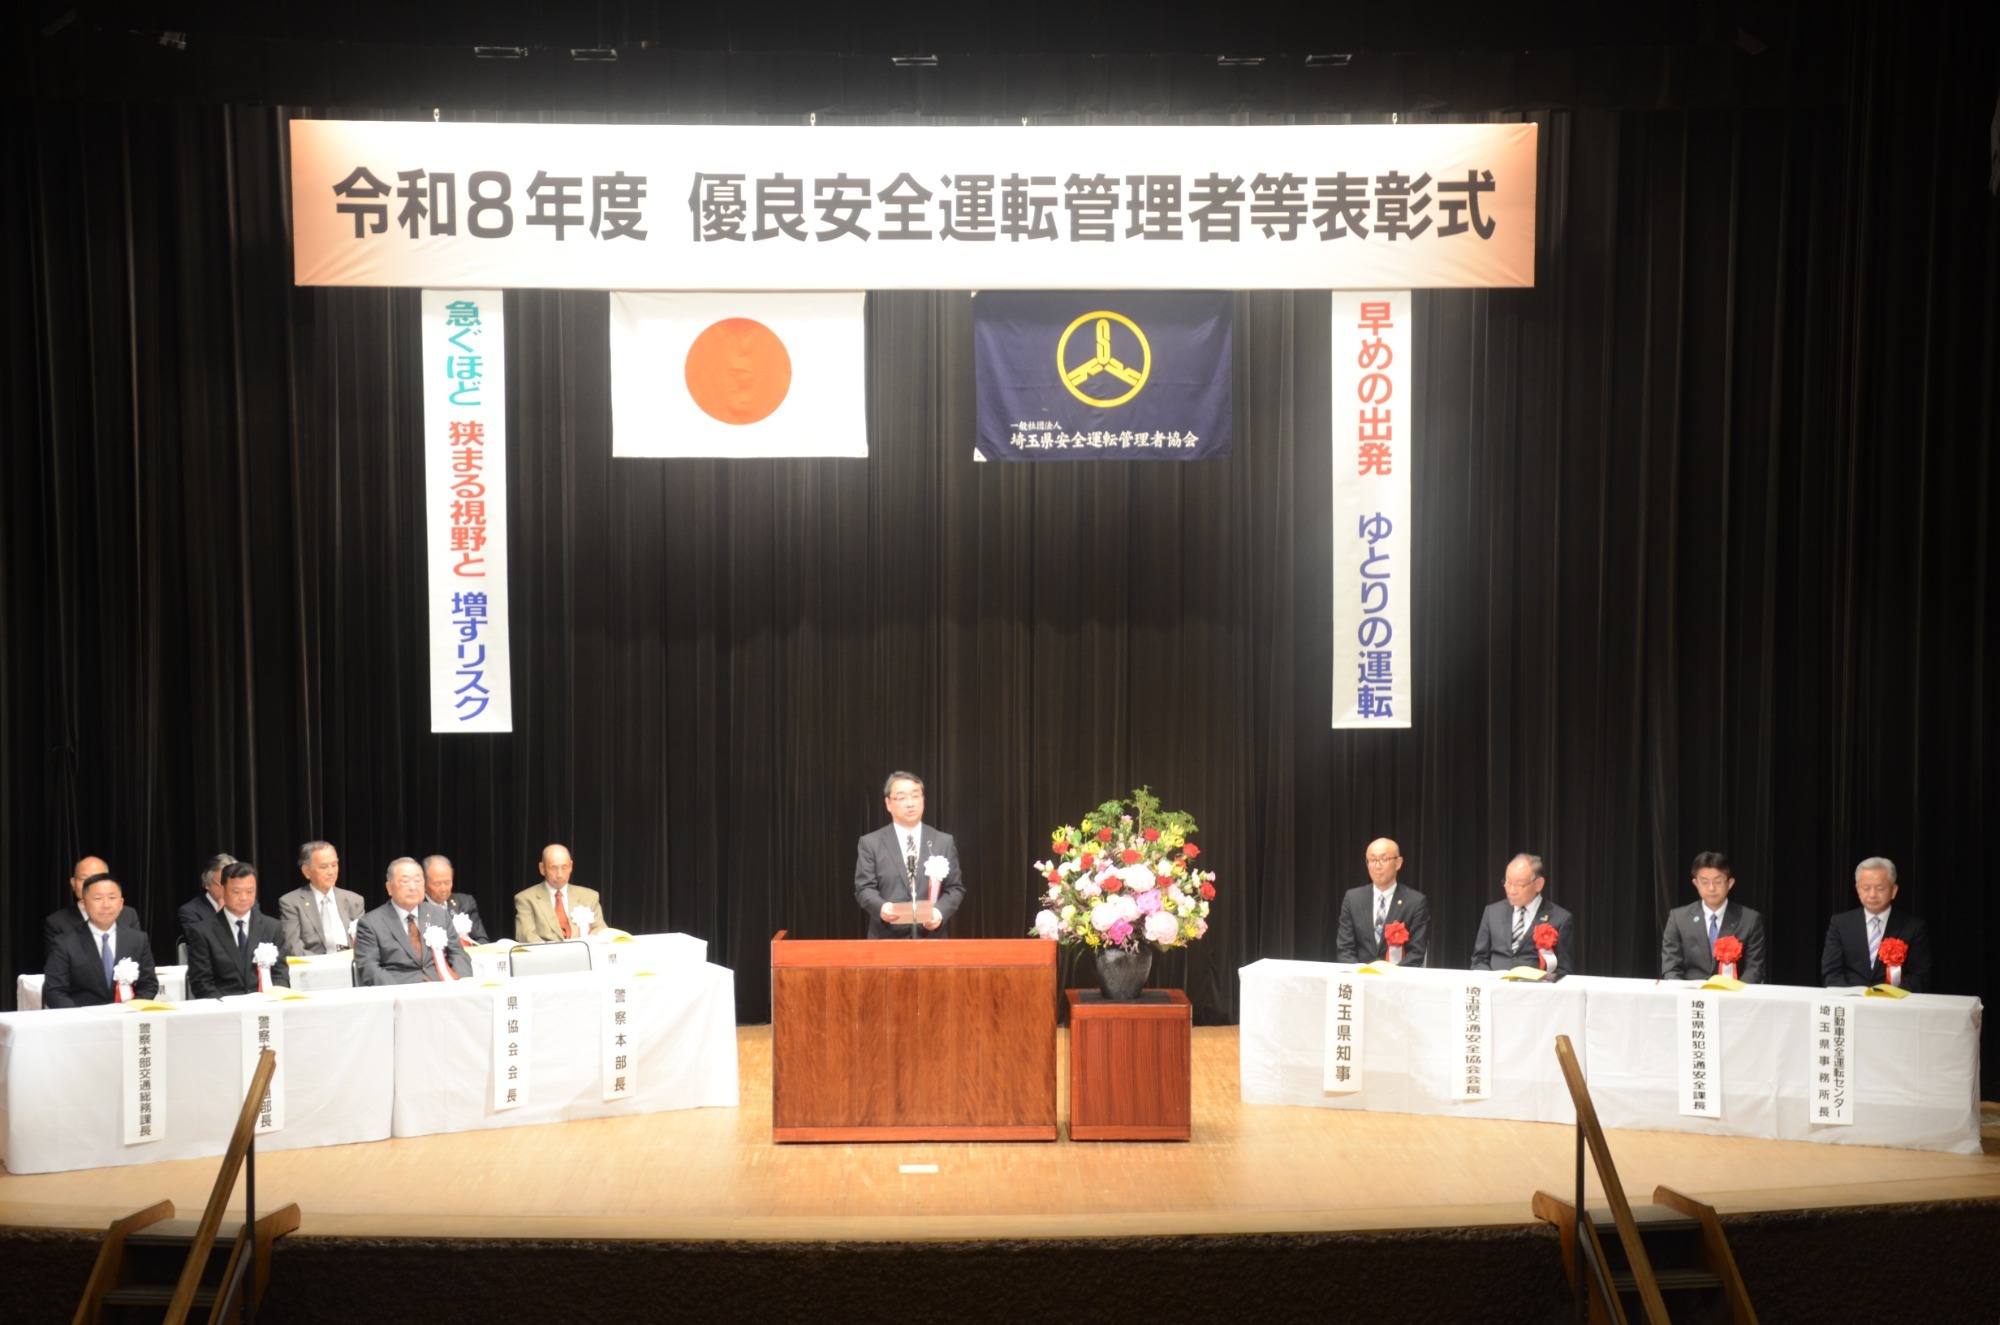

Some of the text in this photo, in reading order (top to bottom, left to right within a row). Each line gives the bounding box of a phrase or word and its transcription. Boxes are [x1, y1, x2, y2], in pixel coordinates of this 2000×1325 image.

[332, 166, 1497, 243] 令和8年度 優良安全運転管理者等表彰式
[1010, 420, 1062, 431] 一般社団法人
[1010, 430, 1199, 450] 埼玉県安全運転管理者協会
[445, 300, 490, 721] 急ぐほど 狭まる視野と 増すリスク
[1357, 302, 1394, 719] 早めの出発 ゆとりの運転
[138, 1022, 152, 1137] 警察本部交通総務課長
[507, 996, 519, 1103] 県協会会長
[614, 988, 627, 1092] 警察本部長
[1335, 983, 1353, 1082] 埼玉県知事
[1464, 986, 1482, 1095] 埼玉県交通安全協会会長
[1691, 1000, 1706, 1110] 埼玉県防犯交通安全課長
[1818, 1005, 1831, 1118] 埼玉県事務所長
[1833, 1006, 1846, 1118] 自動車安全運転センター
